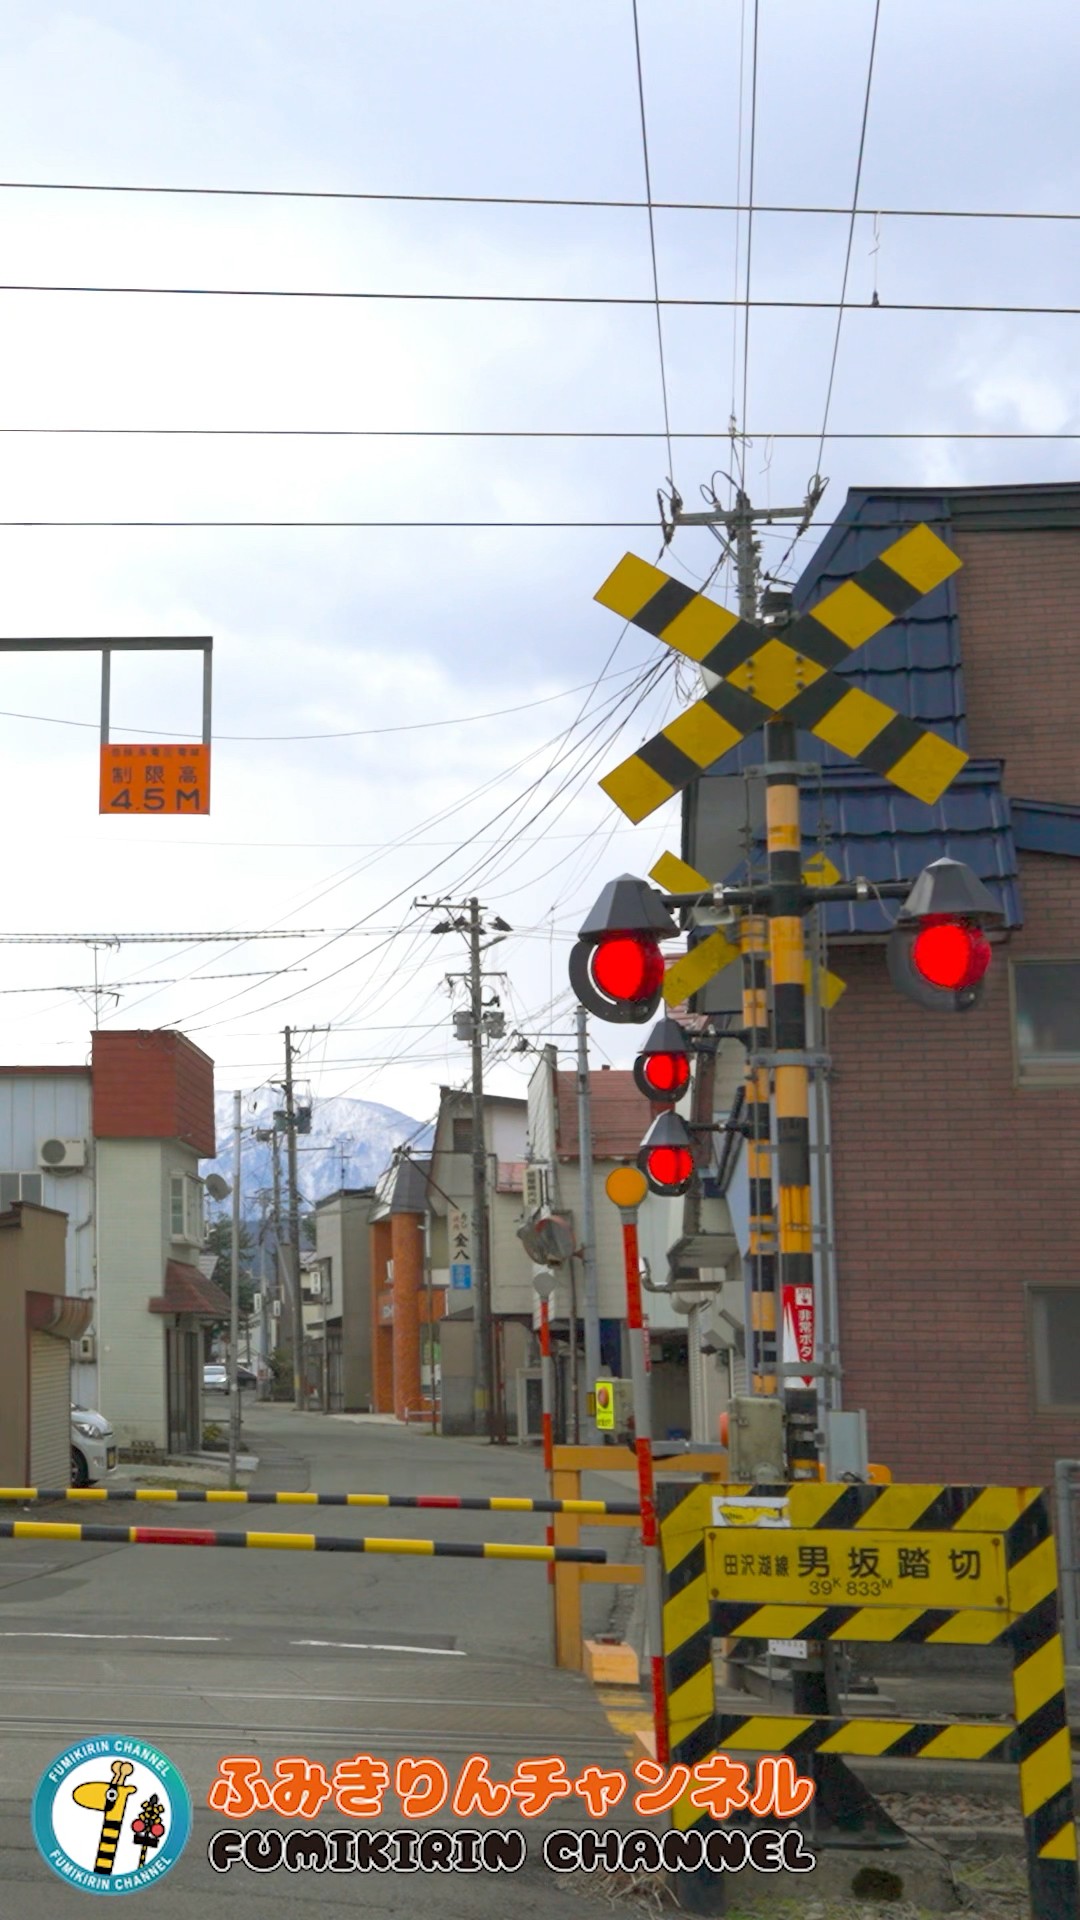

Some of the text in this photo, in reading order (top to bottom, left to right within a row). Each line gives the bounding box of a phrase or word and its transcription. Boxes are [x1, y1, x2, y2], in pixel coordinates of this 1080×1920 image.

[724, 1546, 981, 1581] 田沢湖線 男坂踏切
